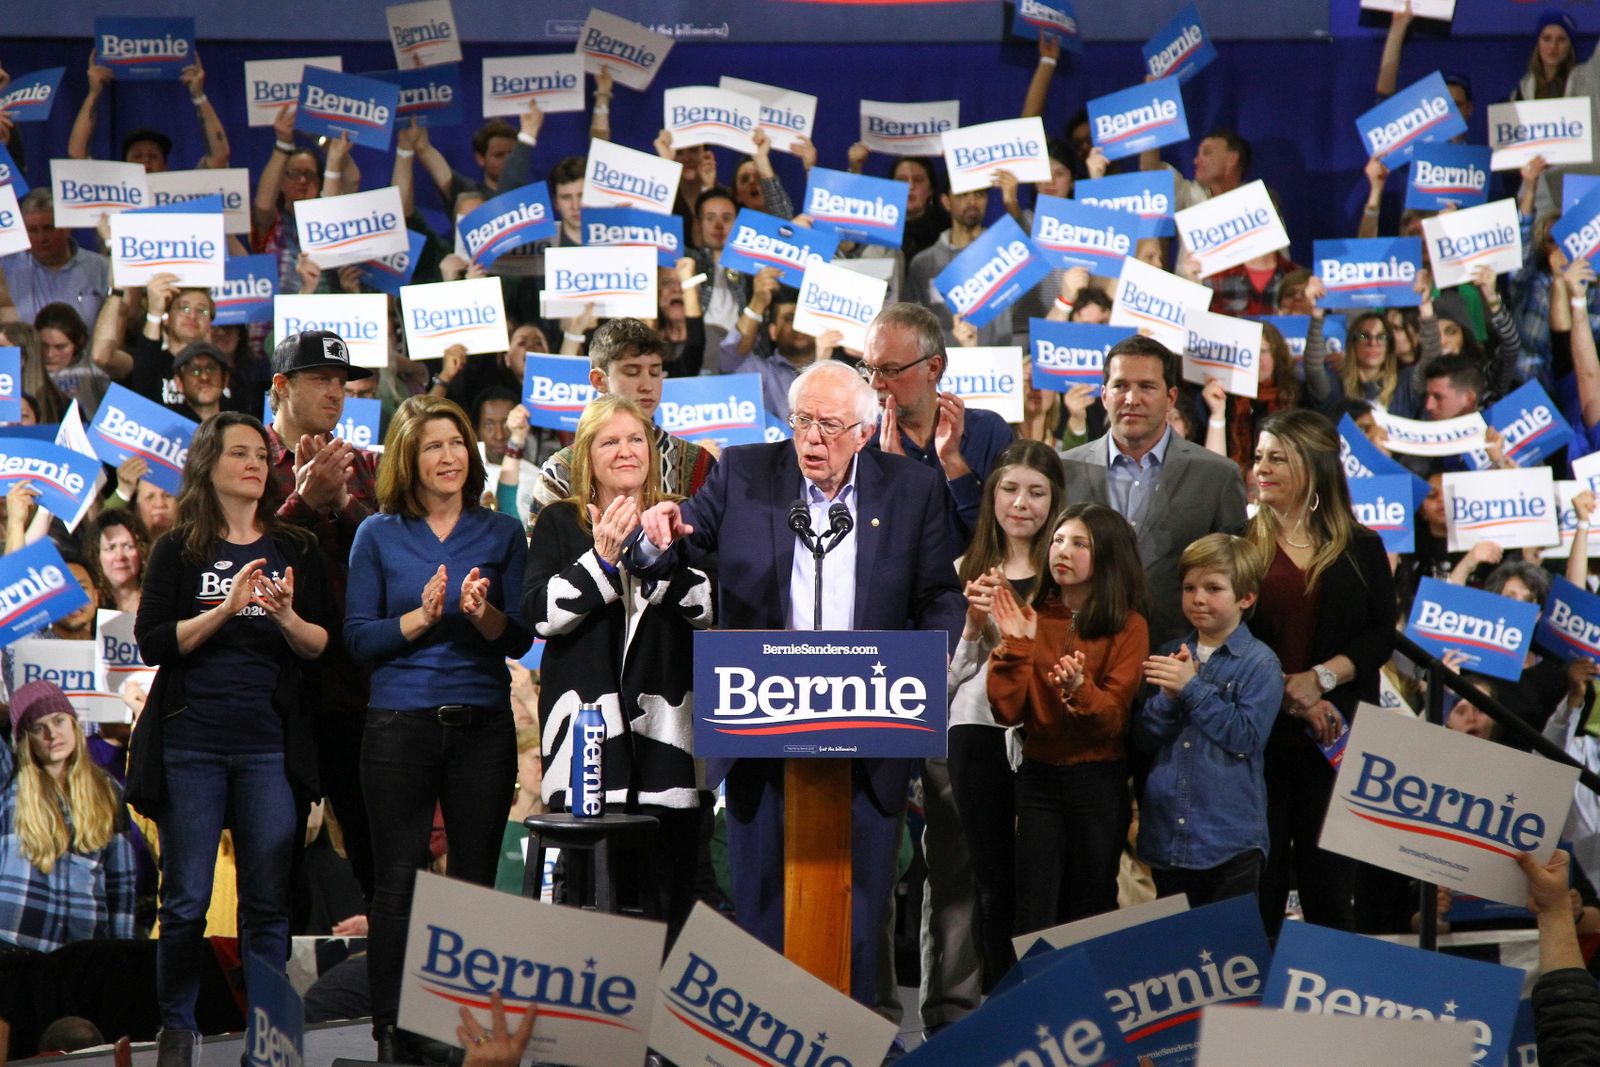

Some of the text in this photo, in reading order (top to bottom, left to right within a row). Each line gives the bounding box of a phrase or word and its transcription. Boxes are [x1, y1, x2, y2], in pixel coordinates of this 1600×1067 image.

[101, 34, 189, 57] Bernie
[393, 19, 452, 49] Bernie
[584, 28, 657, 68] Bernie
[1147, 24, 1203, 77] Bernie
[399, 83, 453, 104] rnie
[490, 70, 577, 93] Bernie
[305, 85, 390, 124] Bernie
[671, 105, 755, 132] Bernie
[1095, 97, 1179, 138] Bernie
[867, 117, 952, 137] Bernie
[1367, 97, 1449, 150] Bernie
[1495, 117, 1584, 144] Bernie
[953, 137, 1040, 168] Bernie
[592, 160, 669, 205] Bernie
[1414, 160, 1486, 189] Bernie
[60, 180, 142, 206] Bernie
[809, 187, 899, 221] Bernie
[305, 210, 398, 243] Bernie
[465, 202, 546, 251] Bernie
[587, 221, 679, 251] Bernie
[1039, 215, 1131, 253] Bernie
[1188, 206, 1271, 251] Bernie
[1436, 222, 1515, 259] Bernie
[120, 235, 216, 260] Bernie
[555, 267, 648, 291] Bernie
[948, 239, 1030, 304] Bernie
[1320, 256, 1416, 282] Bernie
[412, 301, 497, 331] Bernie
[805, 282, 873, 324] Bernie
[284, 316, 378, 340] Bernie
[1187, 329, 1253, 369] Bernie
[941, 370, 1015, 394] ernie
[659, 395, 756, 423] Bernie
[1387, 424, 1478, 441] Bernie
[1451, 492, 1547, 524] Bernie
[1420, 600, 1524, 651] Bernie
[763, 644, 878, 655] BernieSanders.com
[713, 661, 927, 718] Bernie
[583, 723, 605, 815] Bernie
[1350, 752, 1545, 851] Bernie
[421, 924, 637, 1016] Bernie
